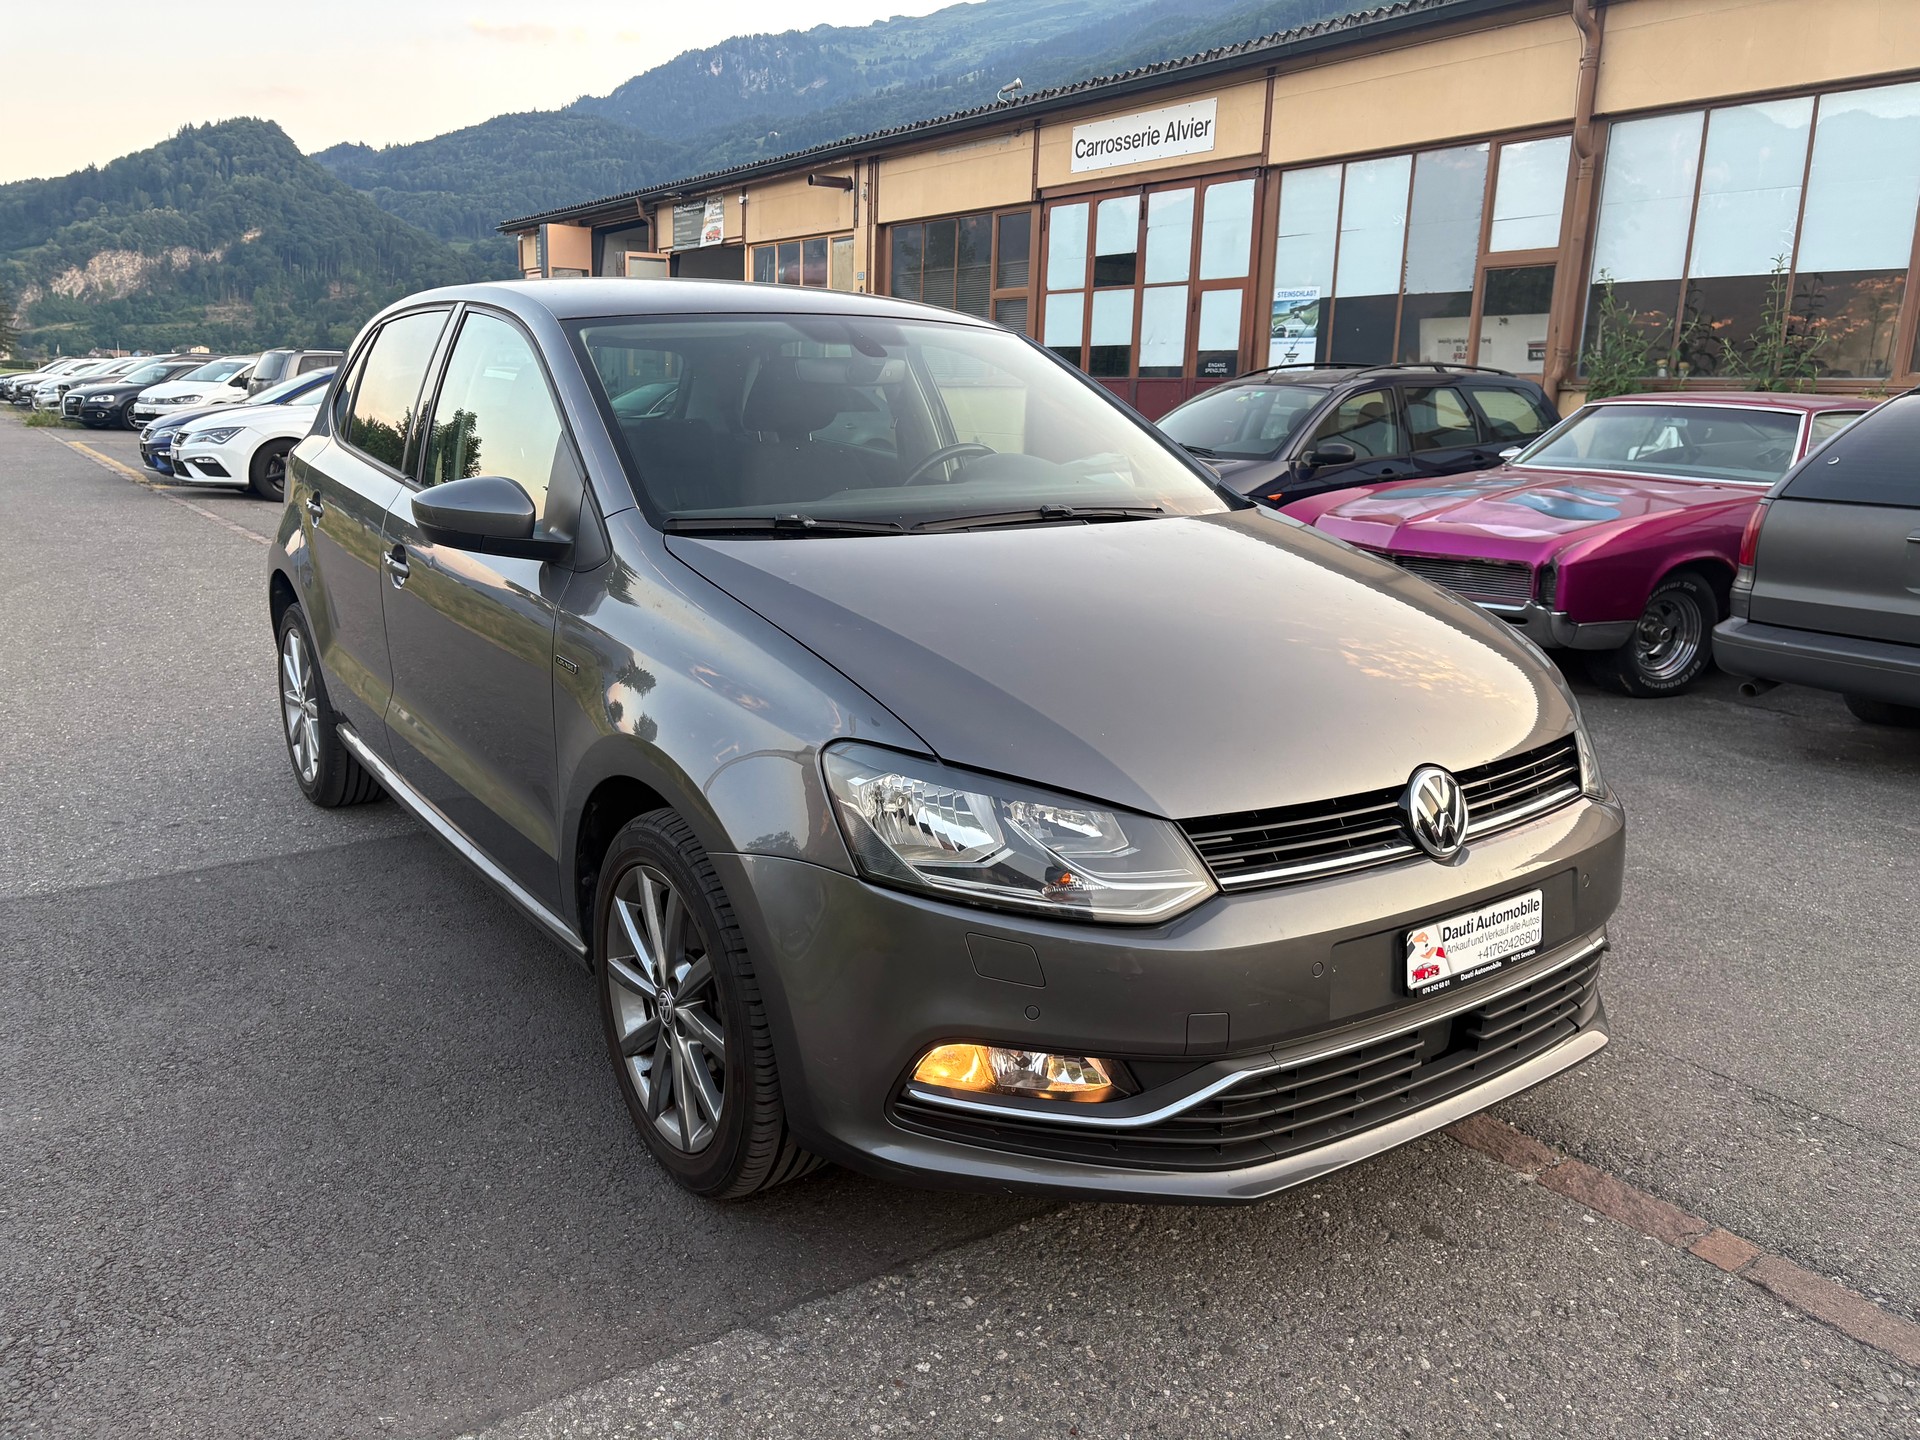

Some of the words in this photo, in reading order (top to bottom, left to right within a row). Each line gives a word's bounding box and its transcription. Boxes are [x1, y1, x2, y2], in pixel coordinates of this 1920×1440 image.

[1075, 125, 1160, 159] Carrosserie
[1164, 117, 1211, 143] Alvier
[1277, 290, 1317, 298] STEINSCHLAG?
[1442, 918, 1474, 943] Dauti
[1476, 898, 1540, 931] Automobile
[1446, 937, 1471, 956] Ankauf
[1470, 933, 1484, 946] und
[1485, 923, 1510, 941] Verkauf
[1510, 921, 1521, 933] alle
[1522, 916, 1540, 929] Autos
[1478, 928, 1540, 959] +41762426801
[1460, 968, 1474, 981] Dauti
[1474, 960, 1502, 977] Automobile
[1431, 984, 1439, 992] 242
